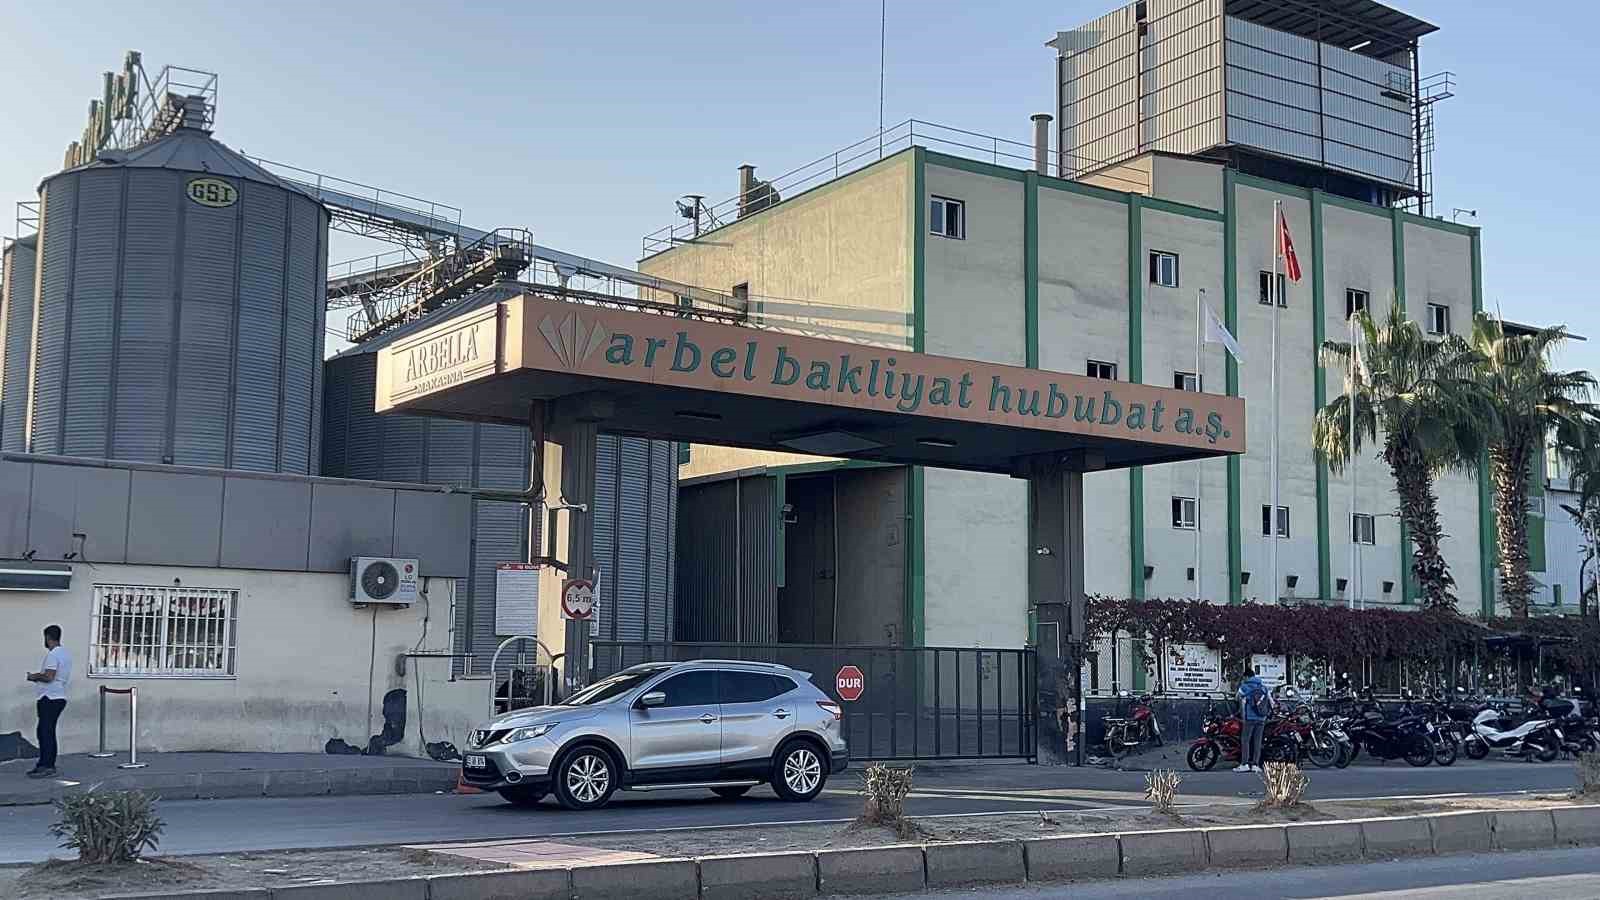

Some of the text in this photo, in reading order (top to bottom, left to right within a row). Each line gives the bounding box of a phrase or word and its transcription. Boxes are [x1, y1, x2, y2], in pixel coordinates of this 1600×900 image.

[192, 183, 233, 202] GSI
[406, 325, 479, 382] ARBELLA
[416, 370, 465, 394] MAKARNA
[605, 331, 1231, 444] arbel bakliyat hububat a.ş.
[566, 593, 581, 605] 6,5
[838, 678, 861, 689] DUR
